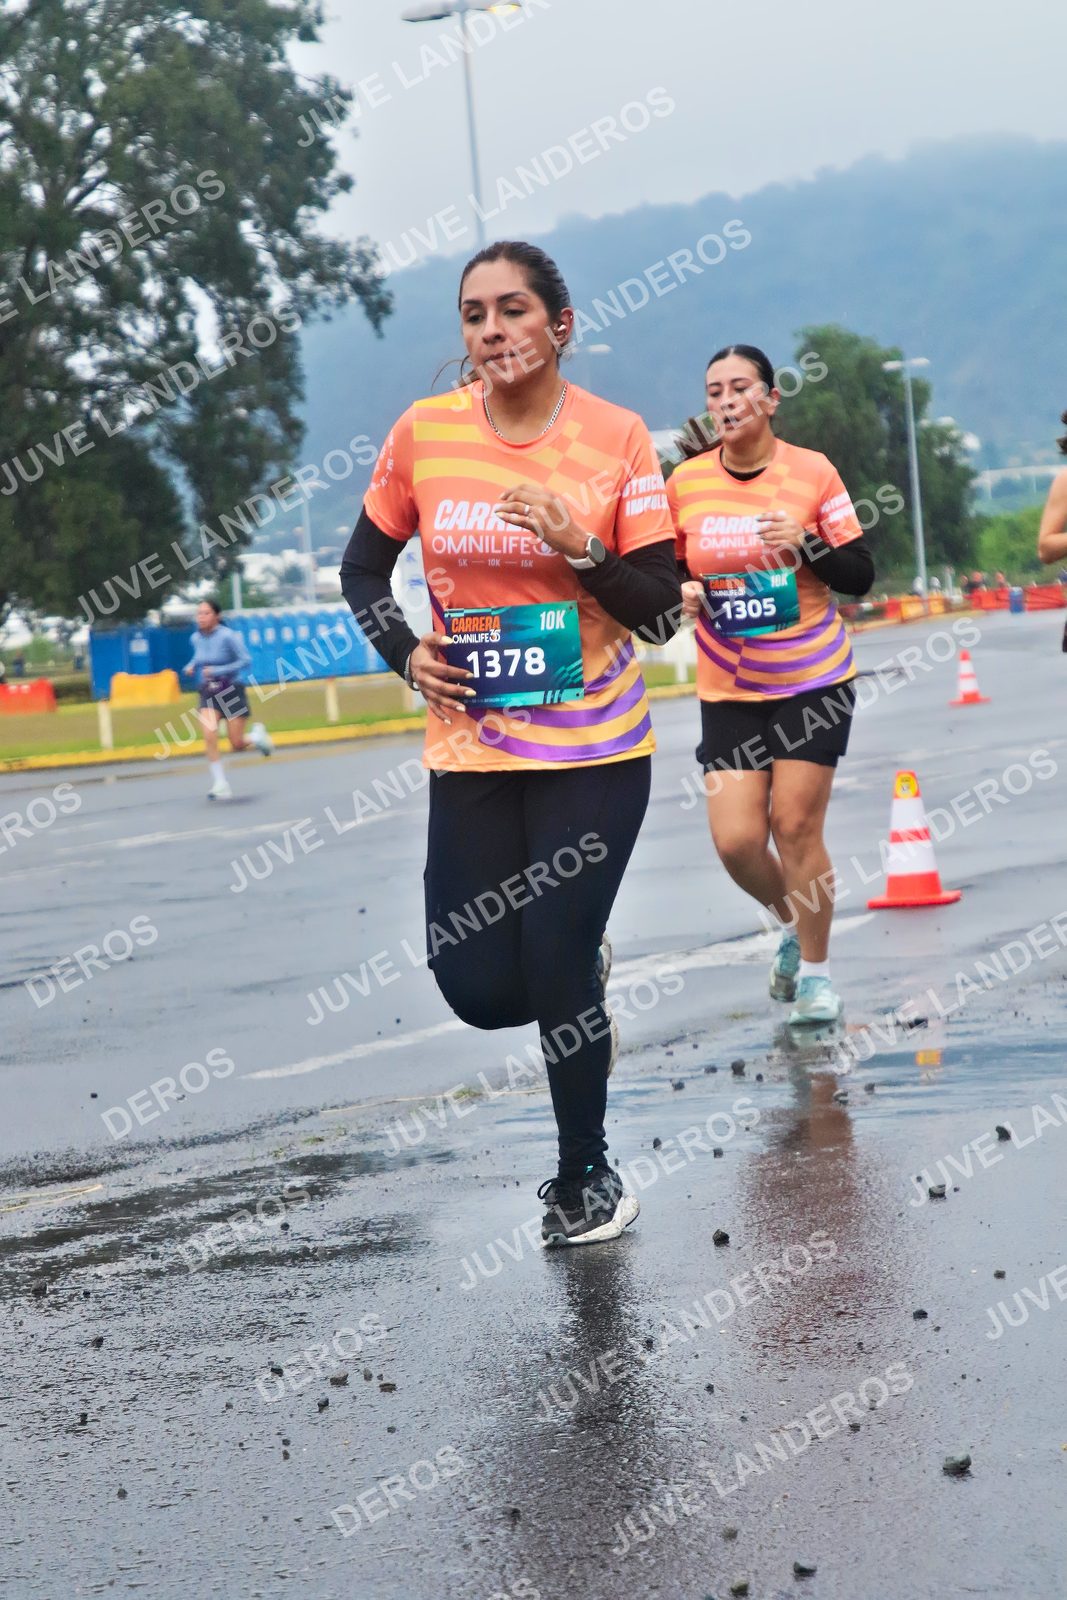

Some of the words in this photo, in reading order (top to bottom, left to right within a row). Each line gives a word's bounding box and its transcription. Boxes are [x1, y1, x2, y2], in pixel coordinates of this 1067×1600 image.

[433, 499, 534, 532] CARR
[432, 534, 532, 555] OMNILIFE
[488, 558, 500, 567] 10K
[722, 597, 777, 620] 1305
[451, 615, 500, 633] CARRERA
[540, 610, 566, 631] 10K
[452, 632, 489, 645] OMNILIFE
[466, 646, 546, 679] 1378
